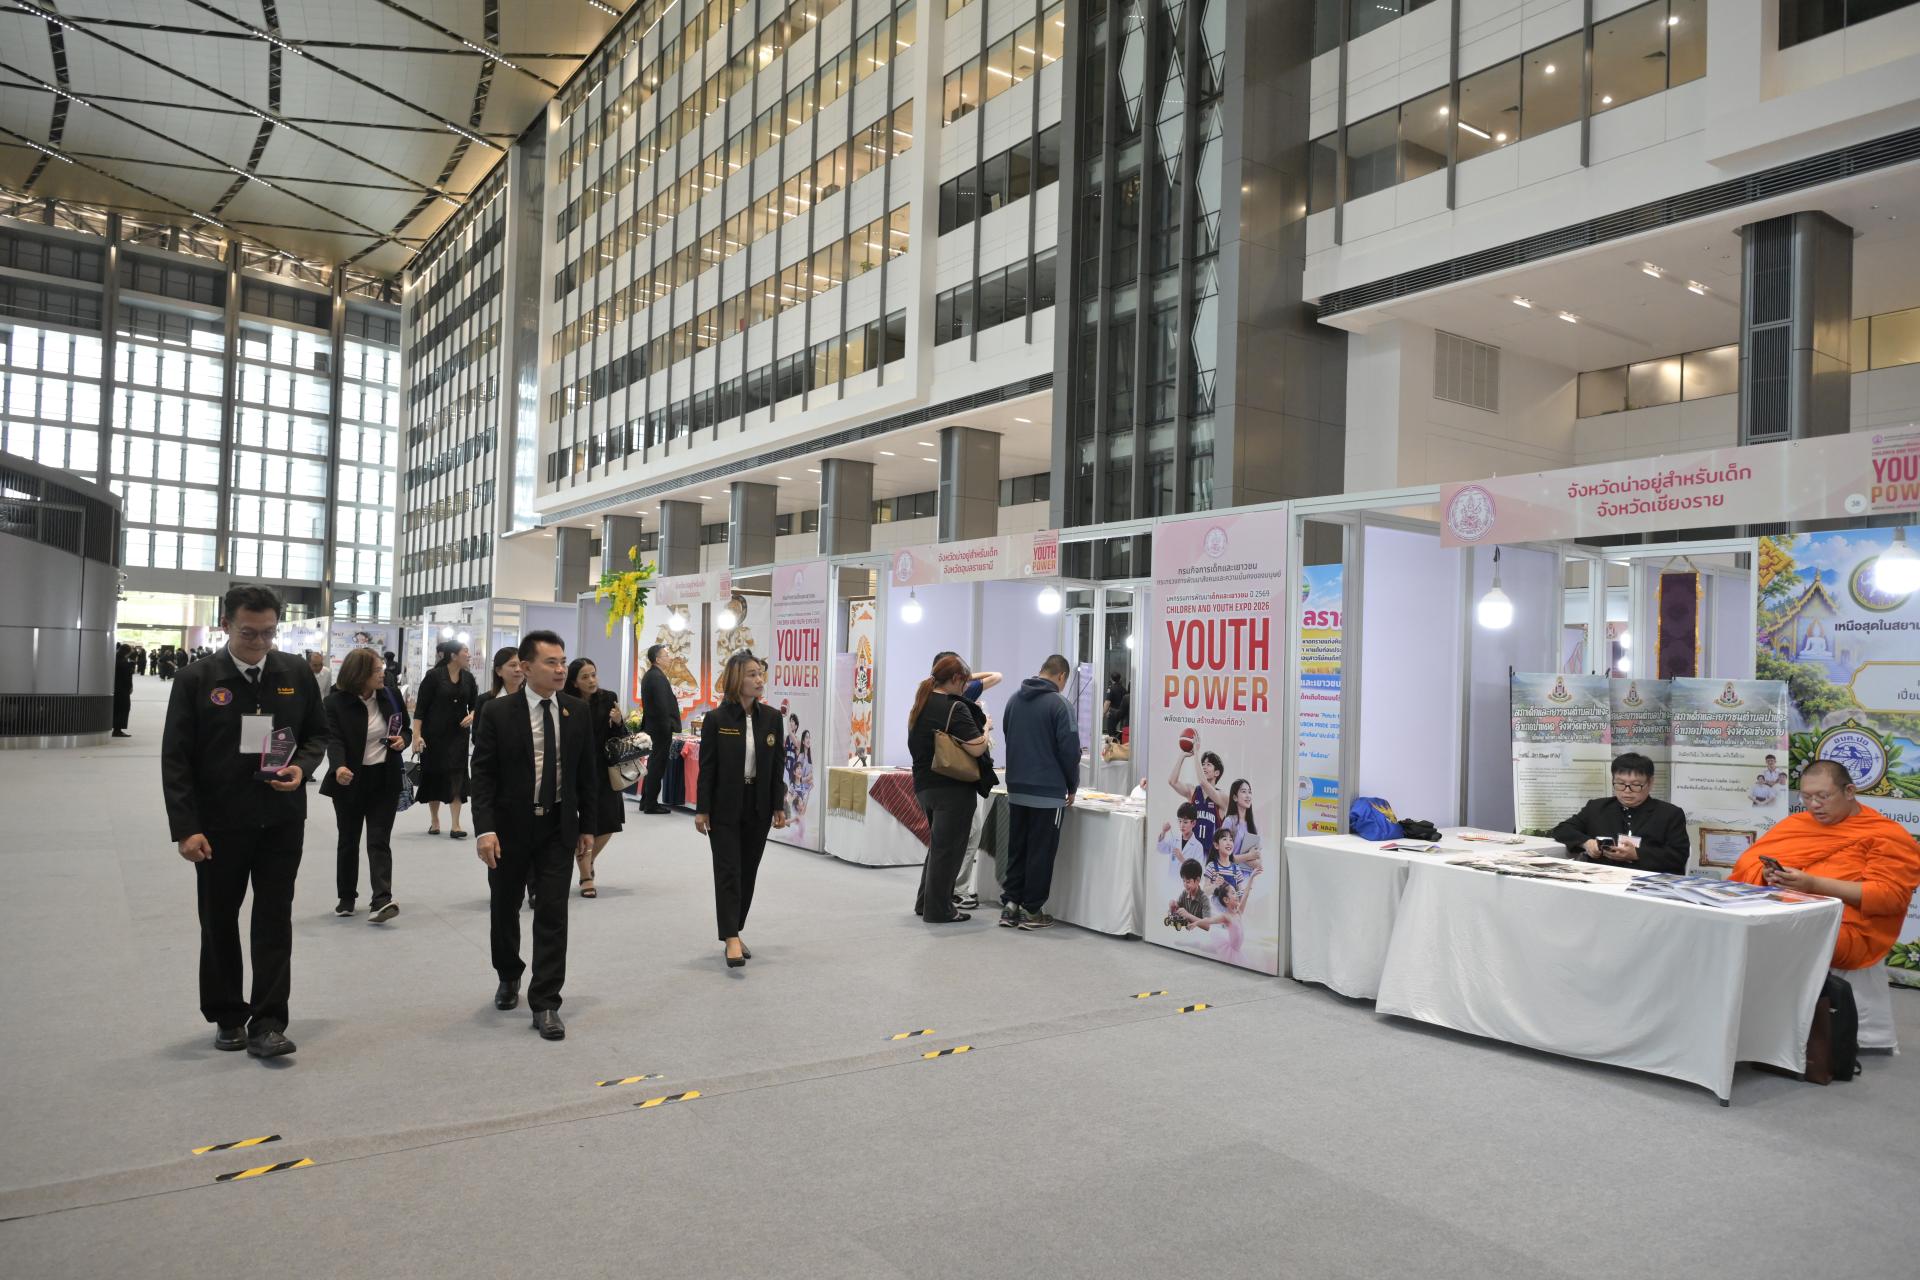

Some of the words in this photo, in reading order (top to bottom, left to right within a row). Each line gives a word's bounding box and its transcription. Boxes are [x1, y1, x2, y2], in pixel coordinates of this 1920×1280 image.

[1568, 463, 1751, 498] จังหวัดน่าอยู่สำหรับเด็ก
[1872, 455, 1920, 483] YOU
[1597, 494, 1724, 517] จังหวัดเชียงราย
[1032, 560, 1056, 571] POWER
[1033, 545, 1056, 560] YOUTH
[1166, 605, 1197, 614] CHILDREN
[1197, 604, 1211, 613] AND
[1213, 603, 1234, 613] YOUTH
[1235, 602, 1252, 612] EXPO
[1253, 601, 1270, 611] 2026
[777, 628, 820, 662] YOUTH
[1166, 617, 1269, 671] YOUTH
[775, 664, 819, 688] POWER
[1164, 674, 1268, 713] POWER
